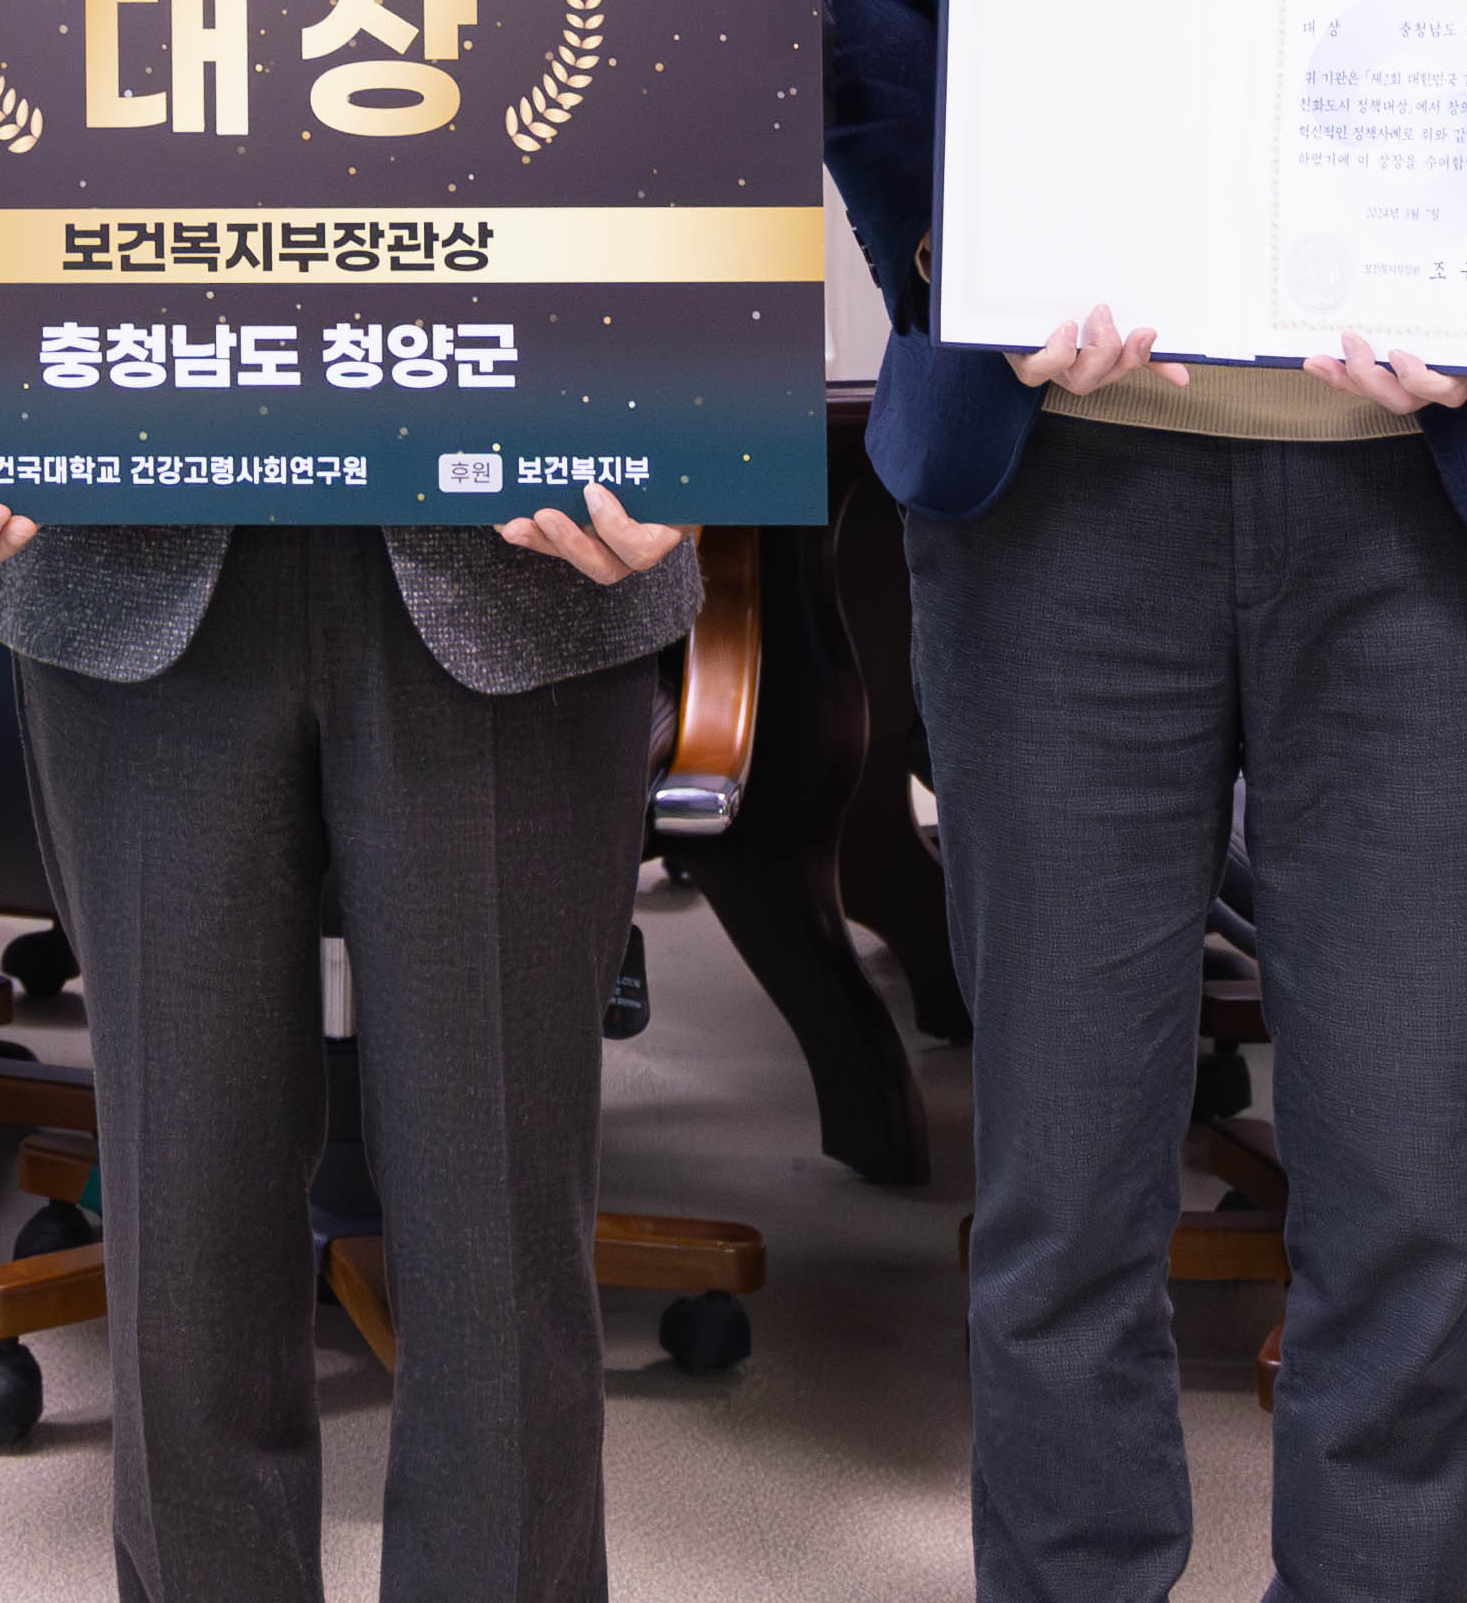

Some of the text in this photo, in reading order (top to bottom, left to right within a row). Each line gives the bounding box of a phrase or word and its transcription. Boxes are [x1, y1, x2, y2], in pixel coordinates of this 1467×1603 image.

[1408, 70, 1457, 86] 대한민국
[62, 220, 494, 273] 보건복지부장관상
[1428, 261, 1447, 280] 조
[39, 322, 518, 388] 충청남도 청양군
[129, 454, 369, 486] 건강고령사회연구원
[449, 459, 492, 486] 후원
[516, 454, 650, 486] 보건복지부
